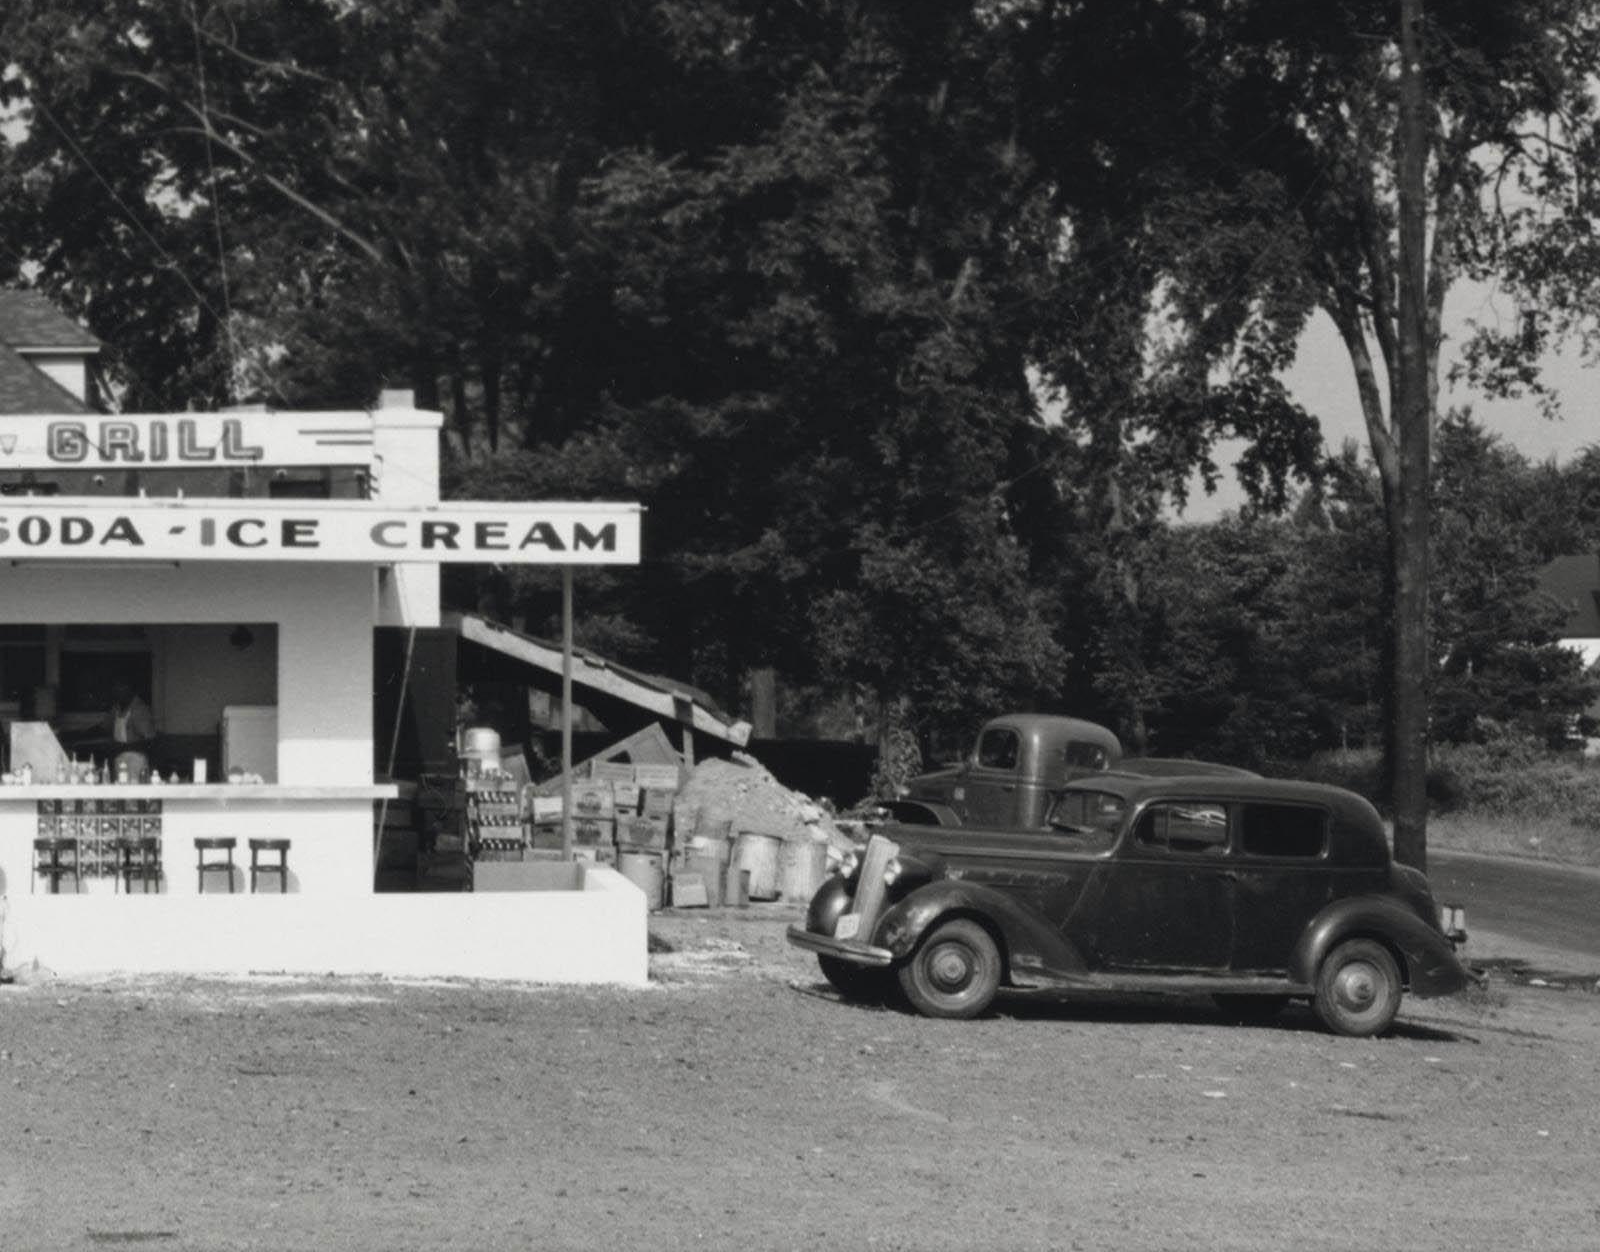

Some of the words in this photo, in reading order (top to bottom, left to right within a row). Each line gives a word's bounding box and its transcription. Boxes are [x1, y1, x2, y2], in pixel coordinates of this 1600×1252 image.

[47, 419, 263, 463] GRILL
[201, 517, 321, 547] ICE
[371, 520, 617, 552] CREAM
